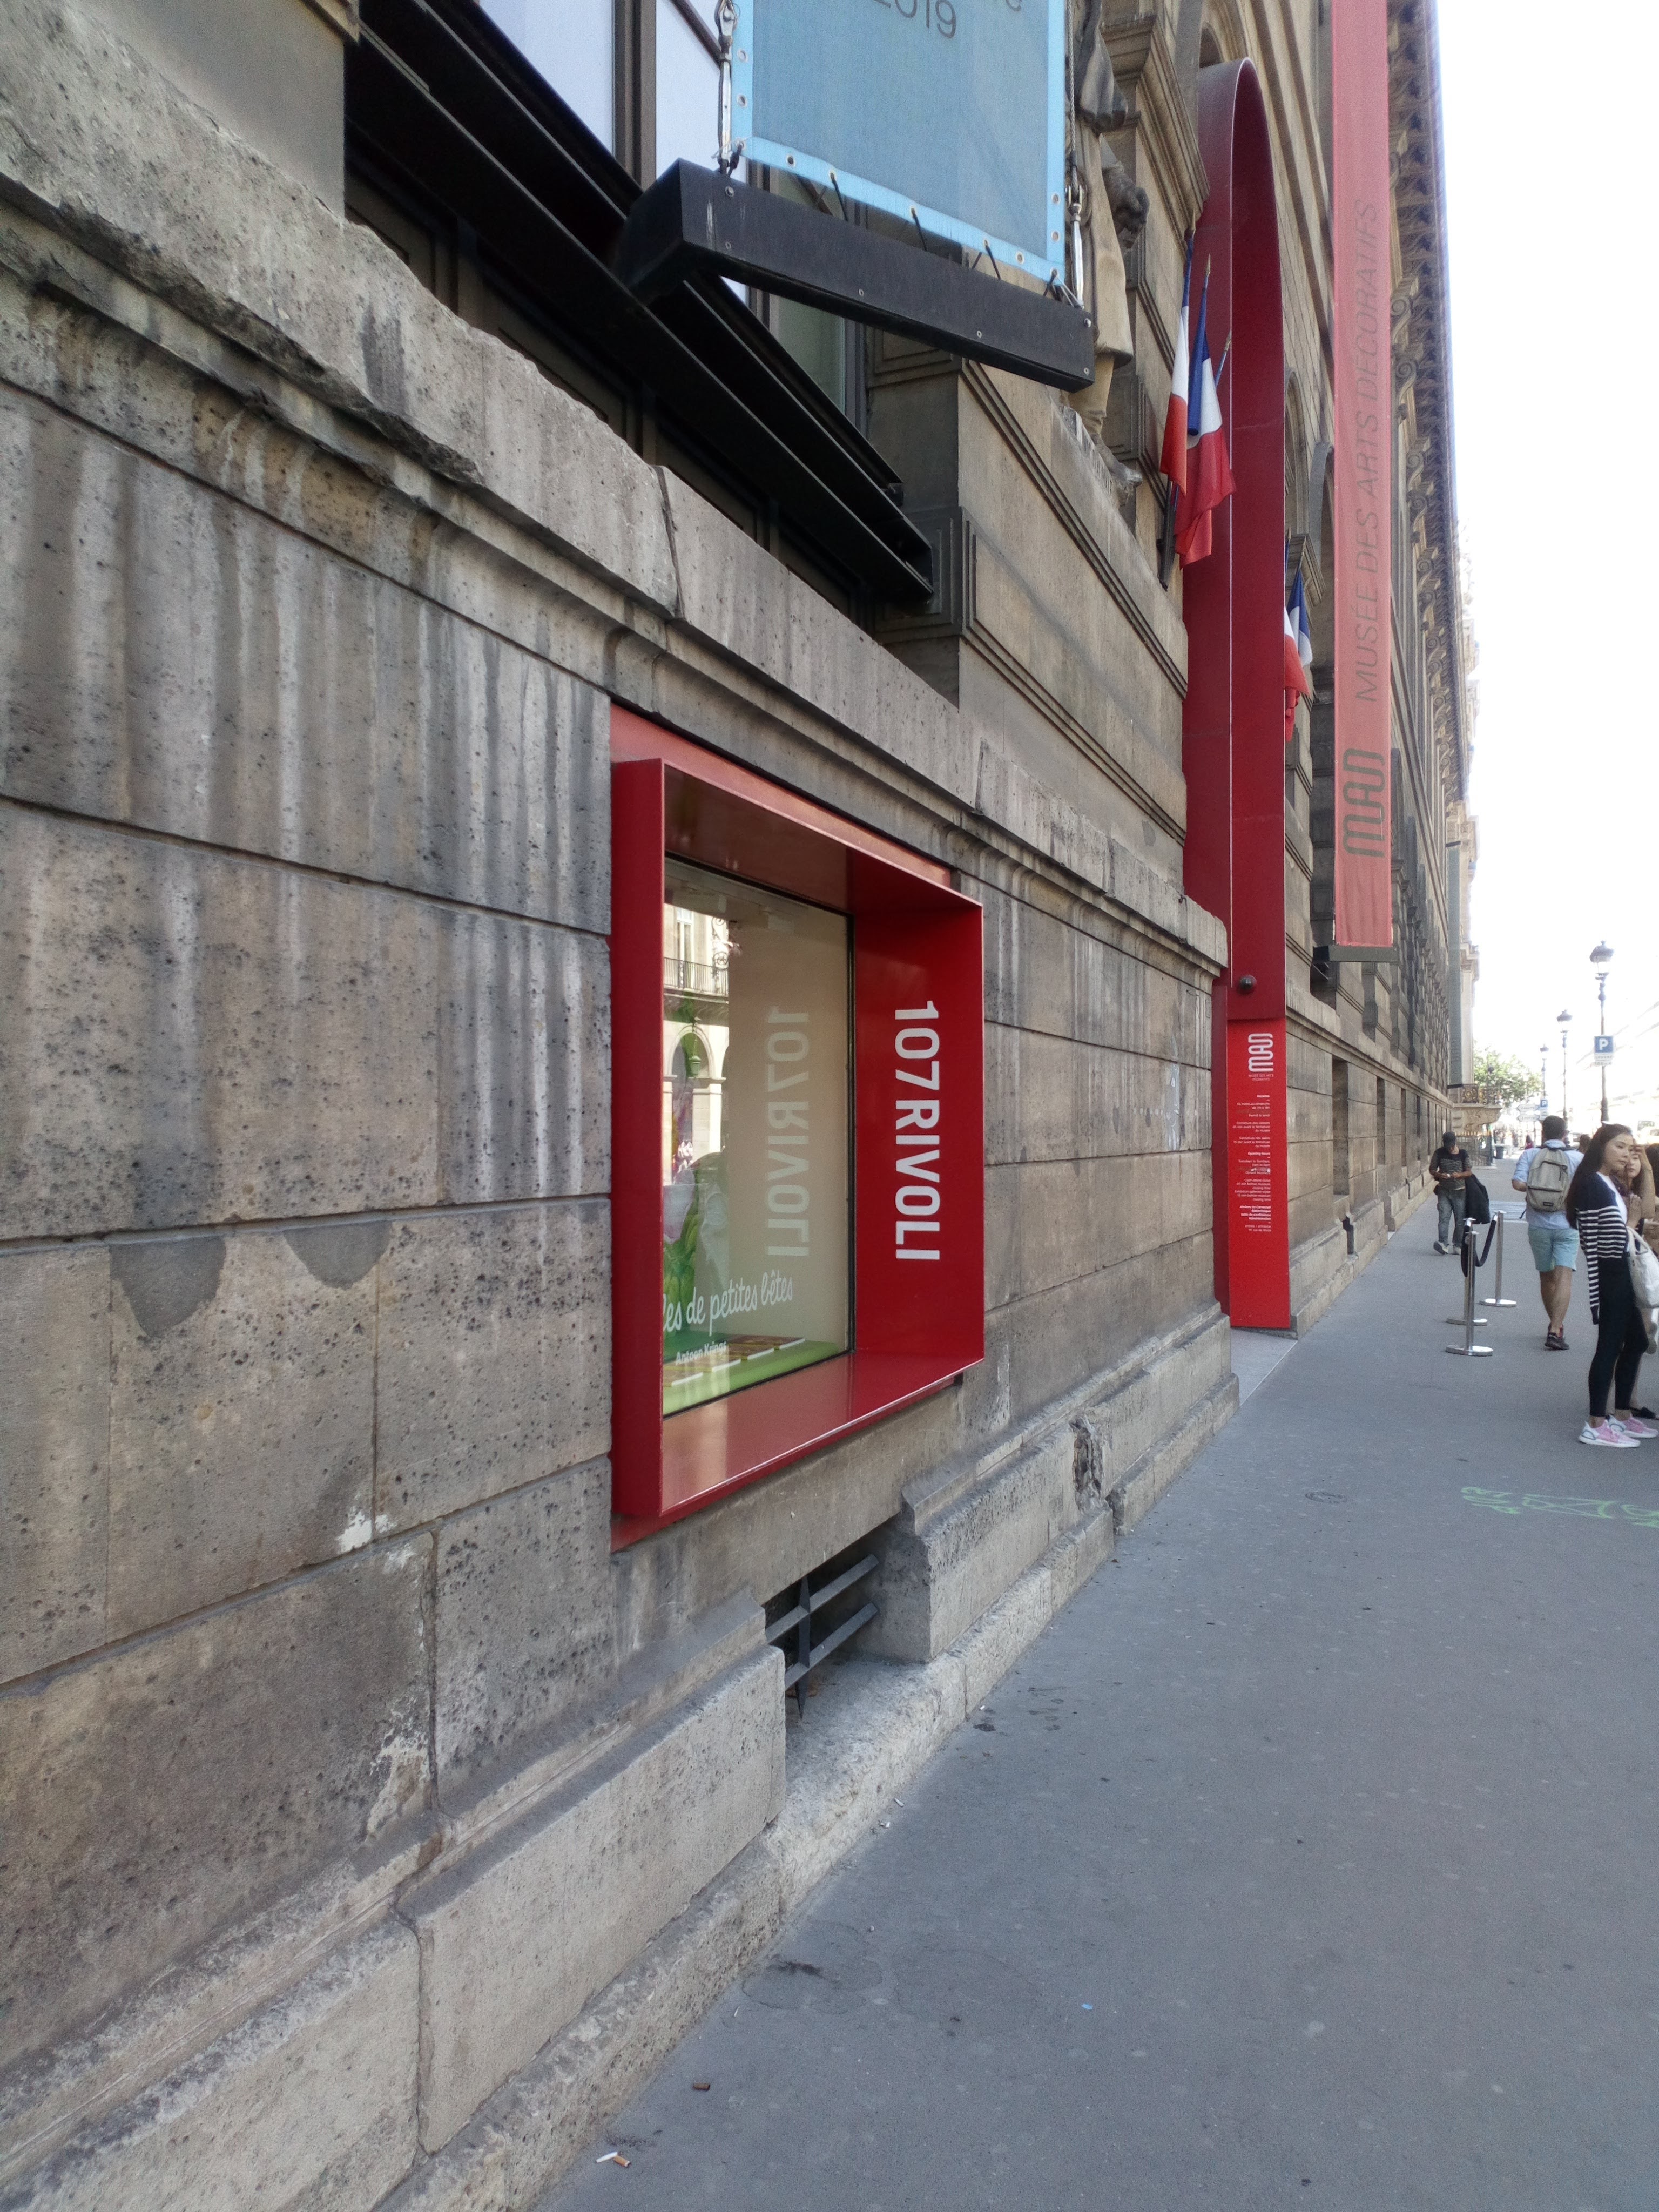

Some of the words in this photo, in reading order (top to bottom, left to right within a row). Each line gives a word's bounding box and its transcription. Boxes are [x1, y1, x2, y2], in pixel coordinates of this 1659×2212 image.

[875, 0, 956, 38] 19
[1356, 410, 1378, 498] ARTS
[1356, 509, 1378, 574] DES
[1351, 584, 1378, 702] MUSÉE
[1343, 748, 1386, 858] MAD
[1247, 1033, 1274, 1073] MAD
[1599, 1038, 1609, 1050] P
[686, 1286, 706, 1324] de
[709, 1277, 758, 1337] petites
[761, 1269, 793, 1306] bêtes
[676, 1349, 703, 1366] Antoon
[704, 1340, 727, 1357] Krings
